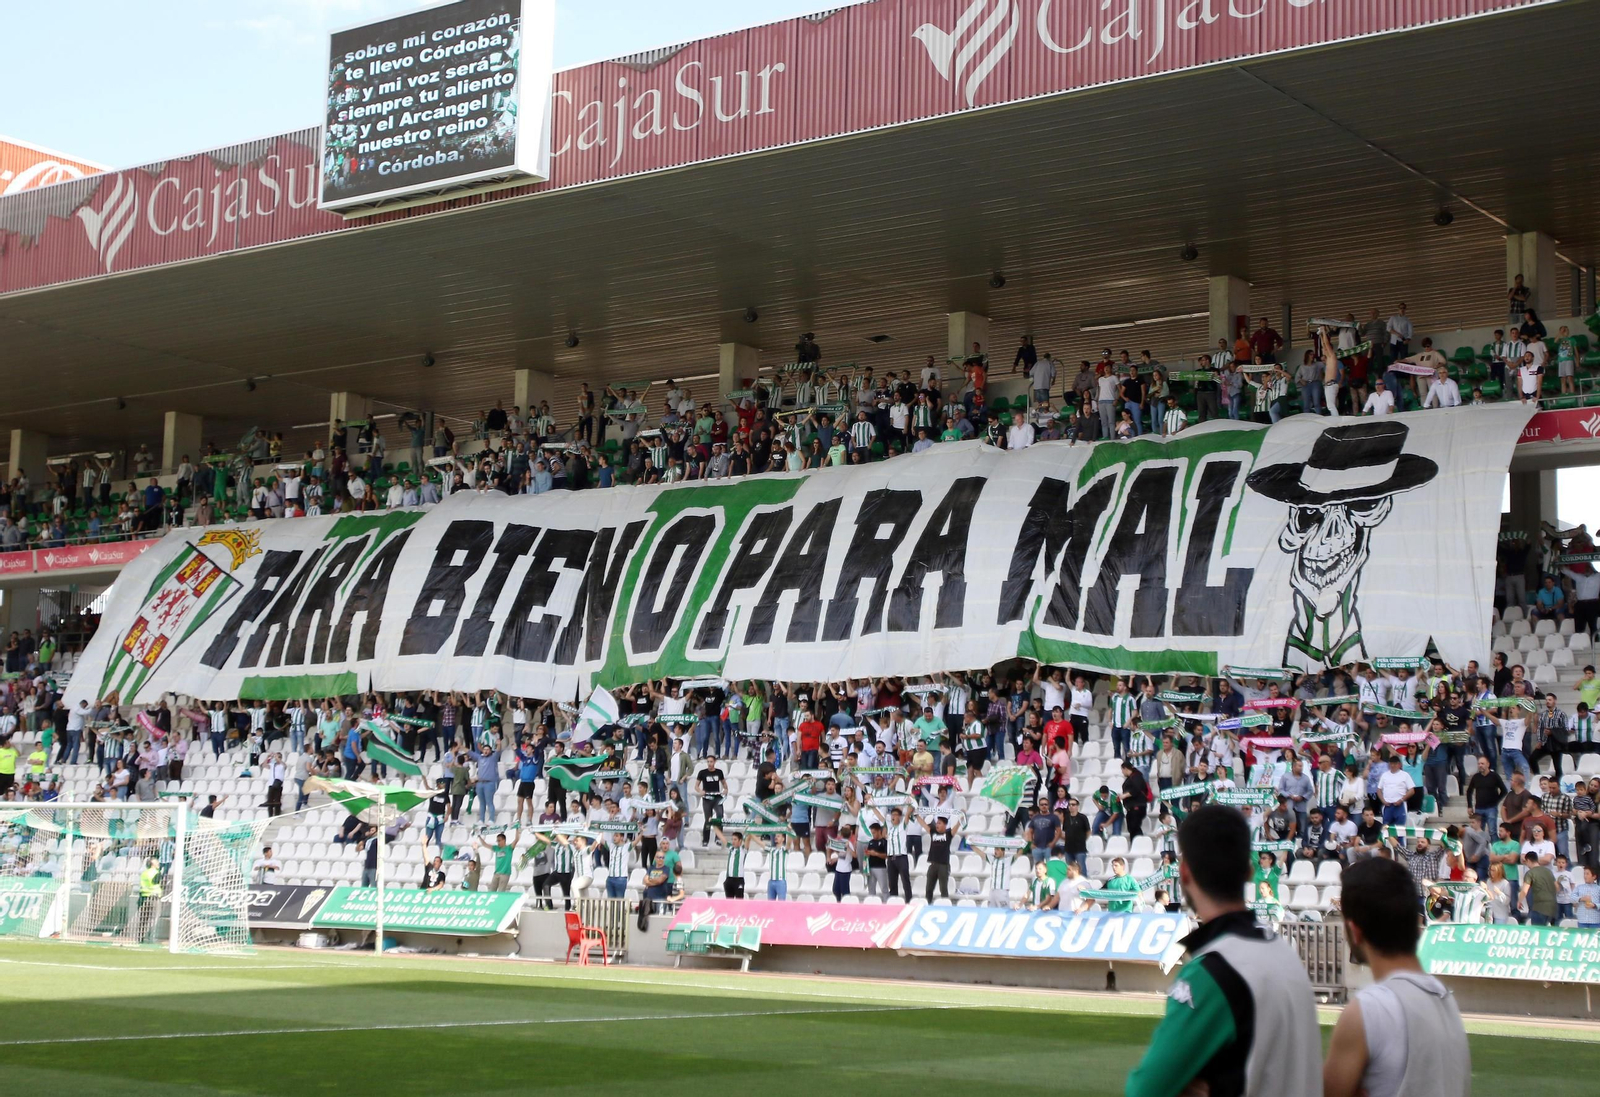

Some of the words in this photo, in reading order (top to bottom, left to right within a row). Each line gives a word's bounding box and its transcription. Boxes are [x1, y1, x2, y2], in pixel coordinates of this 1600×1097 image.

[344, 40, 396, 63] sobre
[402, 31, 426, 50] mi
[432, 12, 511, 42] corazón
[345, 66, 364, 81] te
[370, 55, 414, 76] llevo
[420, 33, 508, 62] Córdoba,
[338, 95, 414, 122] siempre
[420, 88, 439, 104] tu
[445, 72, 514, 98] aliento
[362, 86, 374, 100] y
[378, 76, 402, 95] mi
[407, 71, 440, 88] voz
[445, 56, 489, 79] será
[358, 128, 432, 154] nuestro
[437, 114, 488, 138] reino
[360, 123, 372, 138] y
[376, 116, 394, 132] el
[399, 94, 488, 126] Arcángel
[550, 61, 786, 168] CajaSur
[378, 148, 465, 176] Córdoba,
[147, 154, 318, 248] CajaSu
[200, 527, 415, 668] PARA
[398, 519, 648, 666] BIEN
[694, 476, 988, 650] PARA
[997, 460, 1254, 638] MAL
[347, 889, 498, 906] #ClbdeSociosCCF
[385, 904, 411, 912] todos
[411, 905, 426, 913] los
[426, 906, 472, 915] beneficios
[321, 912, 494, 928] www.corobacf.com/socios
[831, 917, 882, 935] CajaSu
[910, 910, 1176, 955] SAMSUNG
[1462, 926, 1540, 946] CÓRDOBA
[1545, 931, 1570, 947] CF
[1488, 945, 1554, 960] COMPLETA
[1558, 949, 1574, 961] EL
